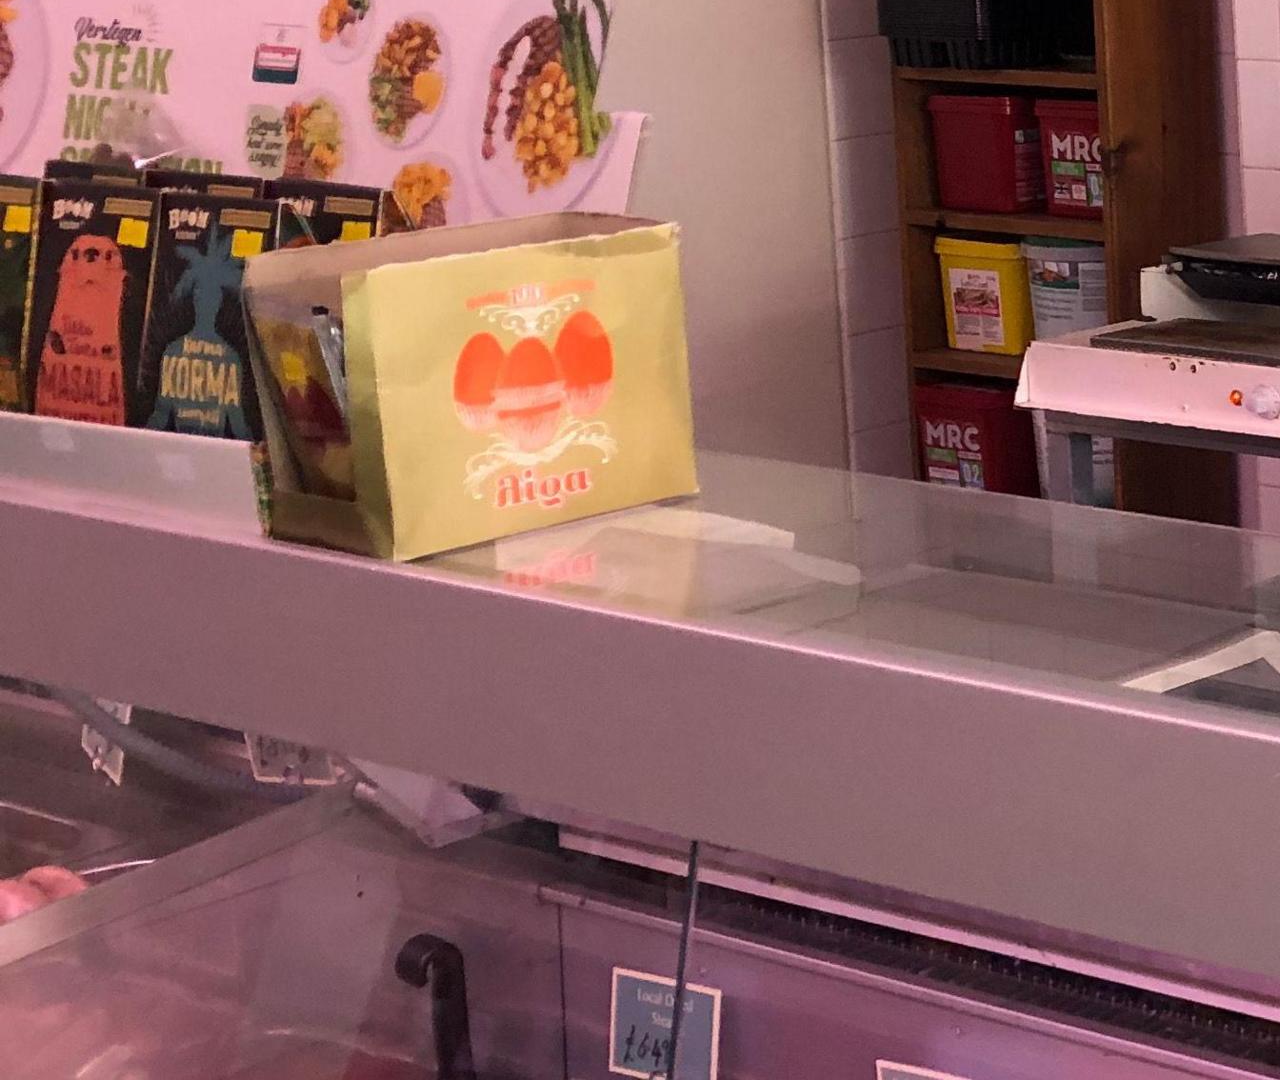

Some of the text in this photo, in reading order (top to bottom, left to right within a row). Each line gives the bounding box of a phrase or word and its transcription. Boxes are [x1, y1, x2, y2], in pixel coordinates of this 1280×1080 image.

[74, 16, 143, 46] Verstegen
[70, 42, 174, 95] STEAK
[161, 355, 240, 406] KORMA
[925, 420, 981, 451] MRC
